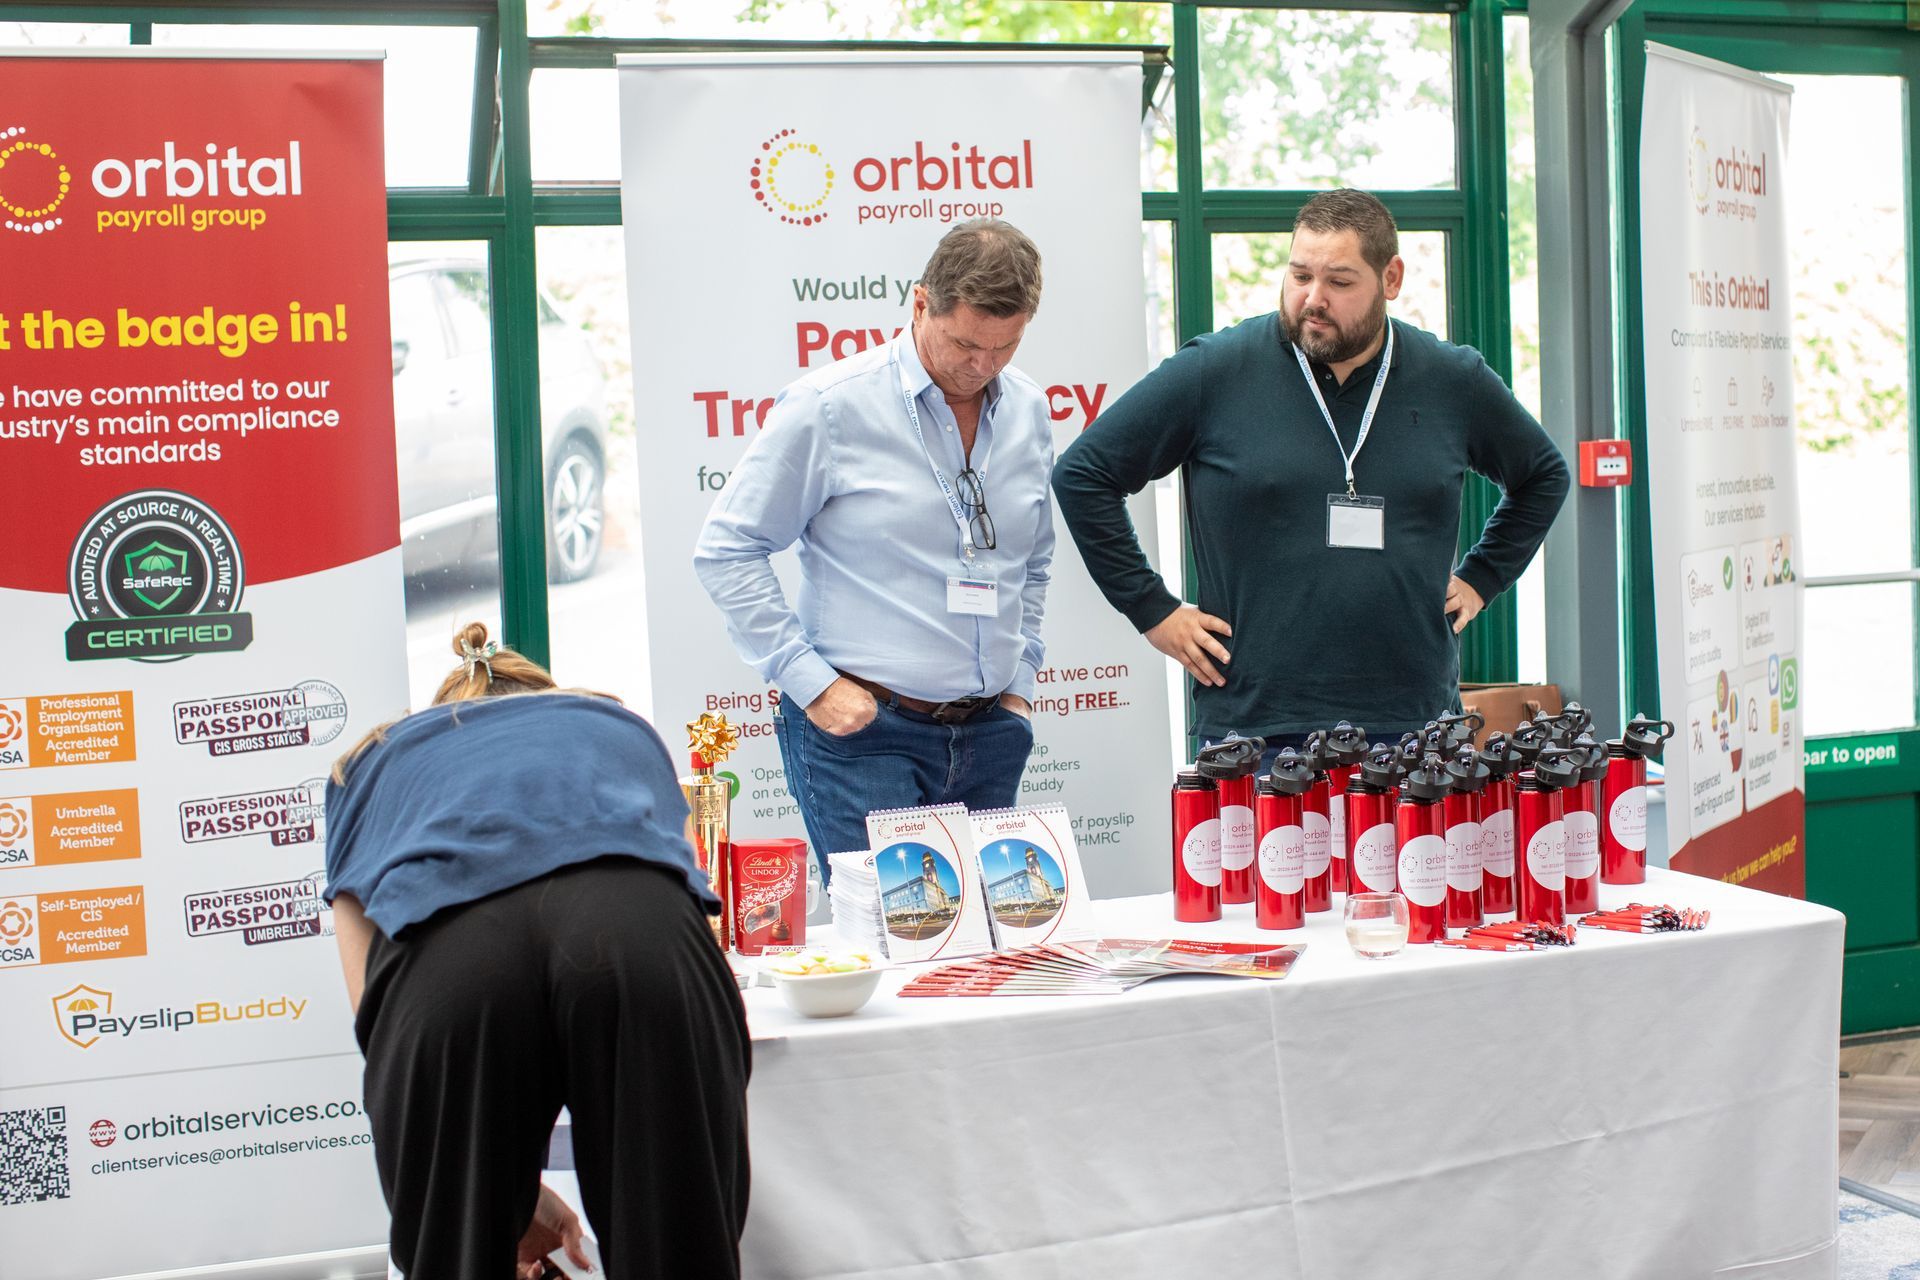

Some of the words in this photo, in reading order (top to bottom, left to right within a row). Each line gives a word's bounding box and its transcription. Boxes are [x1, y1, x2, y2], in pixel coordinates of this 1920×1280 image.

[92, 141, 301, 198] orbital
[853, 140, 1033, 192] orbital
[1715, 147, 1767, 196] orbital
[97, 204, 185, 232] payroll
[191, 206, 266, 231] group
[858, 199, 933, 225] payroll
[939, 200, 1003, 223] group
[1717, 200, 1739, 219] payroll
[792, 274, 887, 302] Would
[1689, 270, 1712, 306] This
[1715, 272, 1726, 308] is
[1728, 275, 1770, 311] Orbital
[21, 310, 105, 349] the
[117, 306, 279, 358] badge
[289, 301, 348, 343] in!
[13, 385, 82, 408] have
[90, 378, 243, 406] committed
[251, 379, 279, 401] to
[286, 378, 330, 401] our
[98, 411, 170, 435] main
[177, 406, 339, 437] compliance
[79, 440, 221, 466] standards
[697, 465, 733, 491] fo
[81, 536, 103, 601] AUDITED
[100, 518, 118, 539] AT
[117, 501, 180, 524] SOURCE
[180, 507, 198, 525] IN
[197, 519, 232, 595] REAL-TIME
[122, 576, 192, 590] SafeRec
[87, 624, 233, 649] CERTIFIED
[706, 691, 762, 713] Being
[1061, 668, 1088, 682] we
[1093, 664, 1129, 679] can
[40, 695, 120, 710] Professional
[178, 693, 302, 719] PROFESSIONAL
[283, 704, 346, 721] APPROVED
[38, 708, 122, 724] Employment
[38, 720, 124, 737] Organisation
[180, 712, 300, 740] PASSPO
[45, 736, 119, 752] Accredited
[214, 739, 231, 754] CIS
[232, 735, 265, 752] GROSS
[267, 731, 303, 748] STATUS
[1832, 746, 1850, 763] to
[1854, 745, 1896, 765] open
[0, 750, 24, 764] SA
[55, 750, 111, 763] Member
[751, 767, 786, 782] 'Ope
[1030, 743, 1049, 756] lip
[752, 789, 769, 800] on
[1027, 759, 1081, 774] workers
[184, 791, 307, 818] PROFESSIONAL
[753, 807, 774, 818] we
[1021, 778, 1064, 793] Buddy
[56, 805, 116, 819] Umbrella
[186, 809, 306, 838] PASSPO
[1070, 816, 1084, 829] of
[1087, 812, 1135, 831] payslip
[50, 821, 123, 838] Accredited
[895, 821, 926, 833] orbital
[996, 820, 1026, 830] orbital
[59, 835, 115, 850] Member
[41, 895, 134, 913] Self-Employed
[189, 884, 312, 911] PROFESSIONAL
[80, 909, 103, 922] CIS
[191, 902, 311, 932] PASSPO
[56, 925, 128, 942] Accredited
[248, 922, 312, 943] UMBRELLA
[0, 947, 35, 962] CSA
[65, 940, 121, 954] Member
[72, 997, 307, 1036] PayslipBuddy
